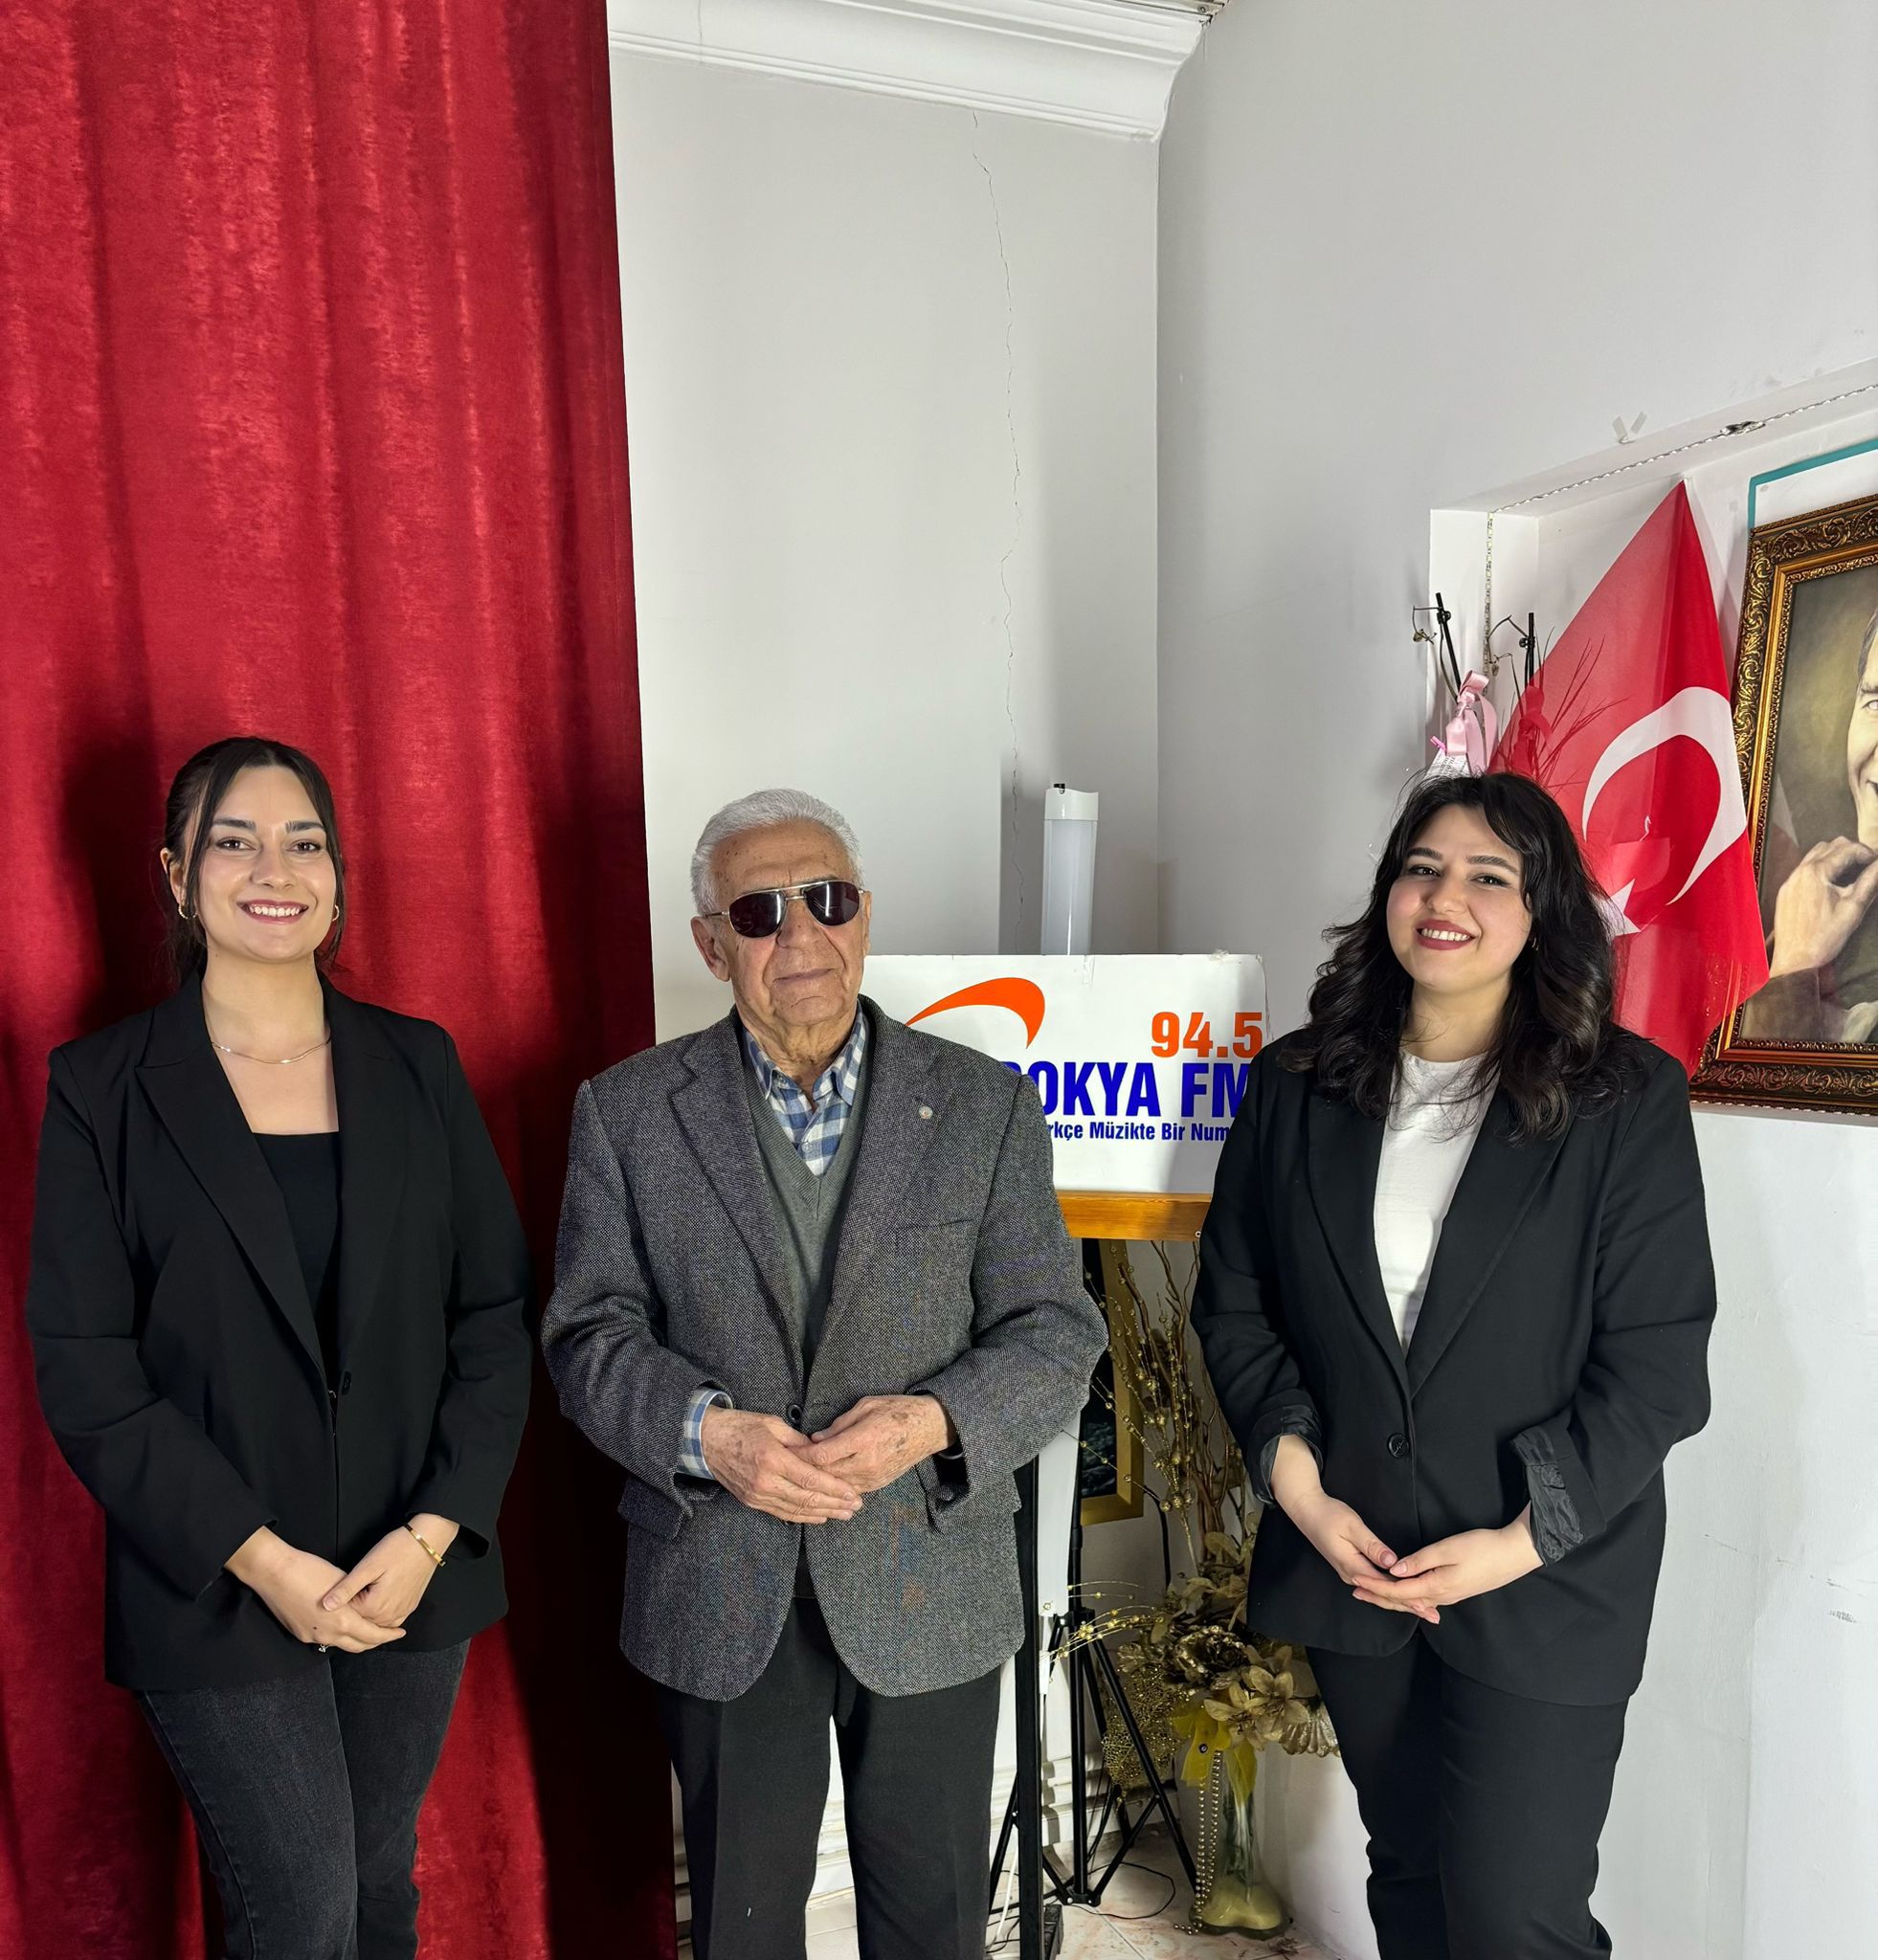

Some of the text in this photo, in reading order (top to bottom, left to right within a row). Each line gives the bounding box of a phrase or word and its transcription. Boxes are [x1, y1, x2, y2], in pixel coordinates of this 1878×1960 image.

[1151, 1012, 1263, 1058] 94.5
[1001, 1060, 1251, 1118] OKYA FM
[1089, 1122, 1155, 1140] Müzikte
[1161, 1123, 1186, 1141] Bir
